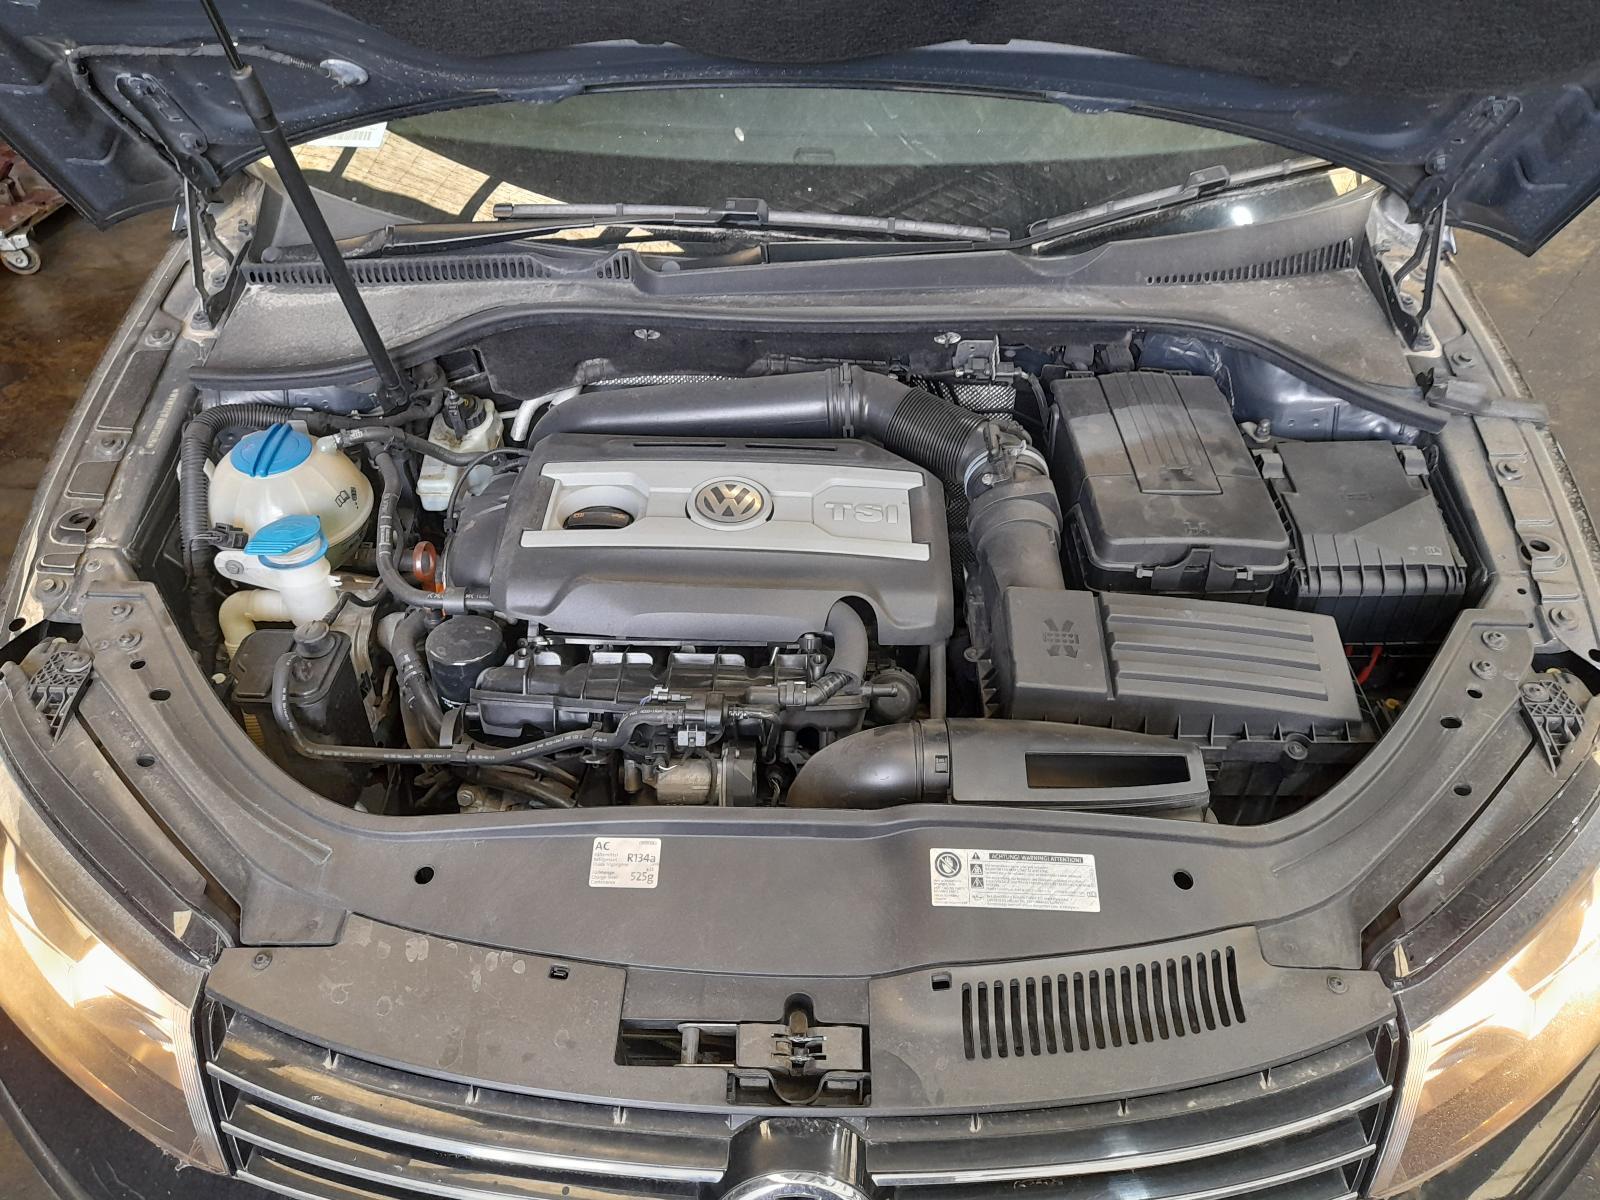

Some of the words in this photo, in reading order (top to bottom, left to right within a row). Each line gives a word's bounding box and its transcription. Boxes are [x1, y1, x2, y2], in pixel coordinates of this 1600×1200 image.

[823, 502, 899, 525] TSI
[595, 841, 611, 851] AC
[626, 853, 656, 863] R134a
[630, 872, 654, 885] 525g
